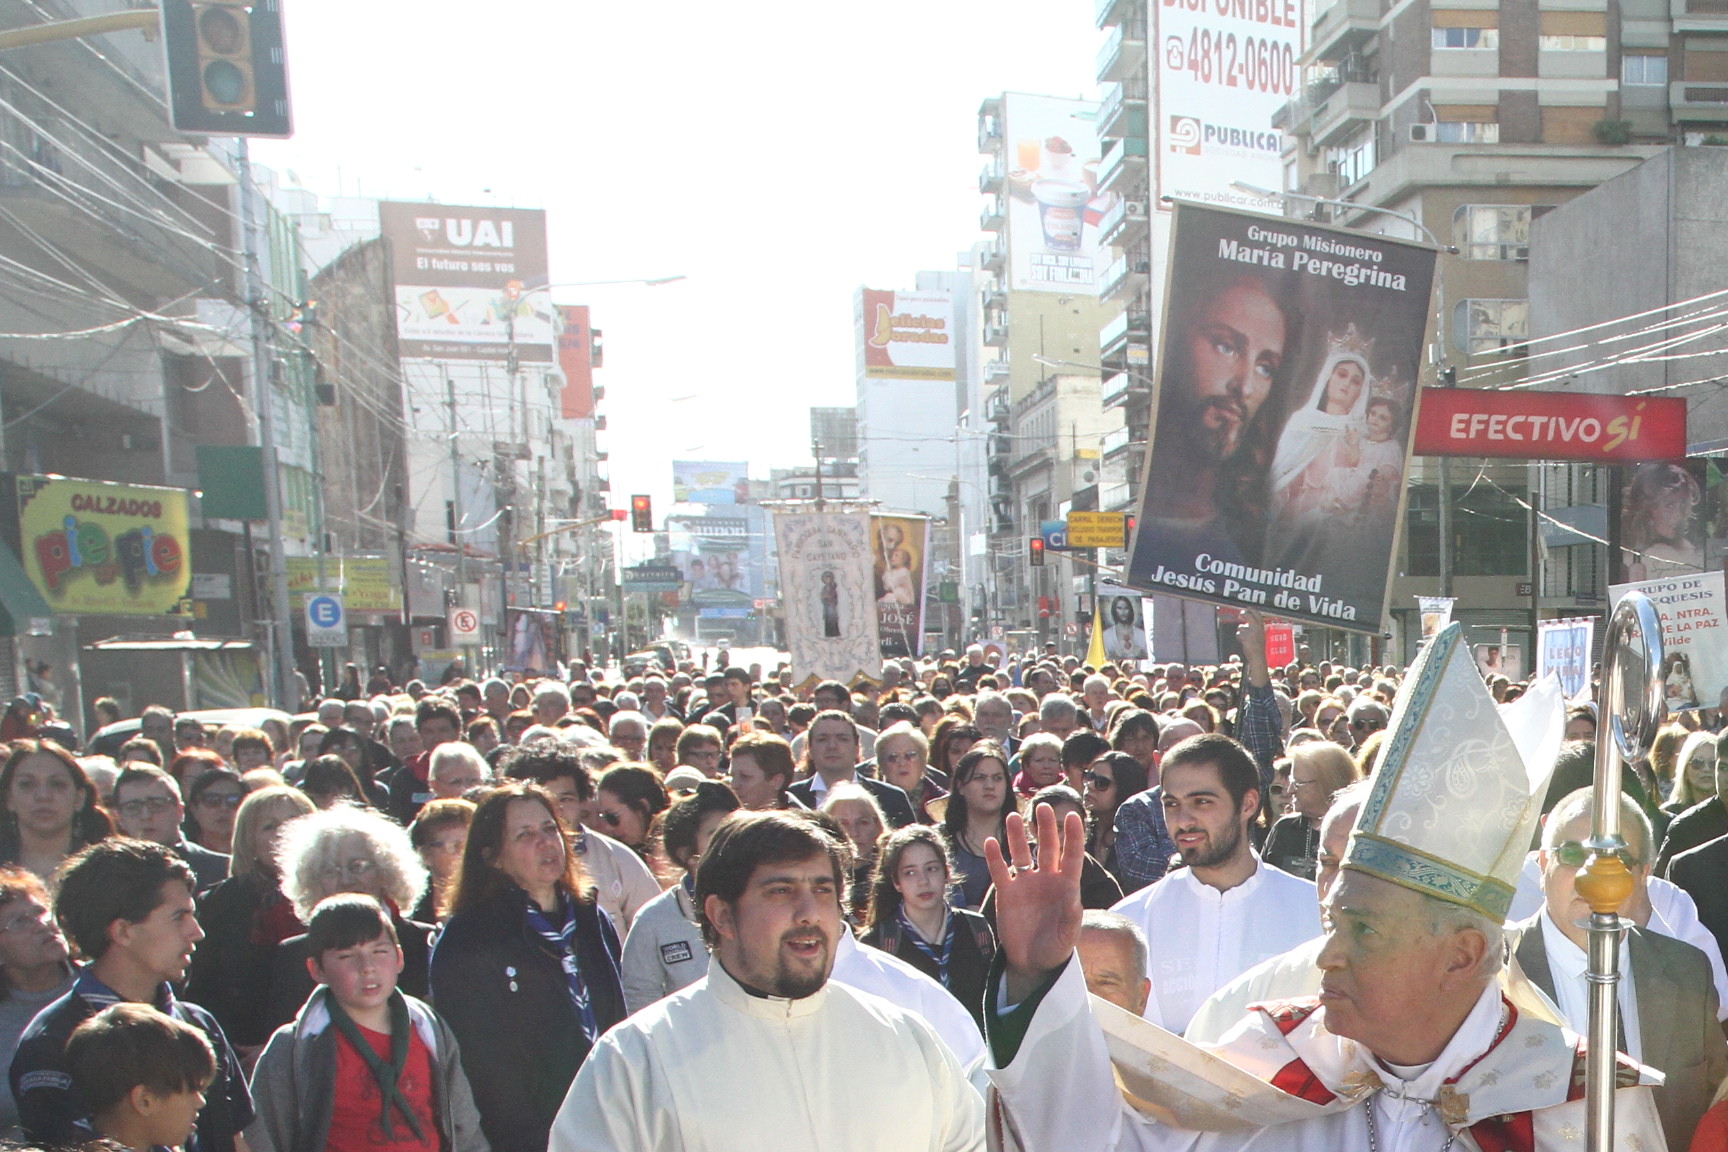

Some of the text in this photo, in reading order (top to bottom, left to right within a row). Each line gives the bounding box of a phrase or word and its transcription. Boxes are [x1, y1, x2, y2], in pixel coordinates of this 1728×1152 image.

[1187, 26, 1294, 95] 4812-0600
[446, 218, 513, 247] UAI
[1247, 225, 1383, 263] Grupo Misionero
[1218, 238, 1407, 292] María Peregrina
[1450, 413, 1601, 443] EFECTIVO
[71, 494, 162, 518] CALZADOS
[818, 539, 833, 547] SAN
[806, 552, 847, 561] CAYETANO
[1195, 553, 1323, 593] Comunidad
[1151, 565, 1356, 621] Jesús Pan de Vida
[1633, 579, 1702, 594] RUPO DE
[1651, 590, 1713, 606] EQUESIS
[318, 602, 334, 622] E
[880, 612, 915, 625] JOSÉ
[1676, 607, 1714, 618] NTRA.
[1677, 623, 1692, 632] LA
[1695, 618, 1720, 629] PAZ
[1549, 646, 1582, 660] LEGO
